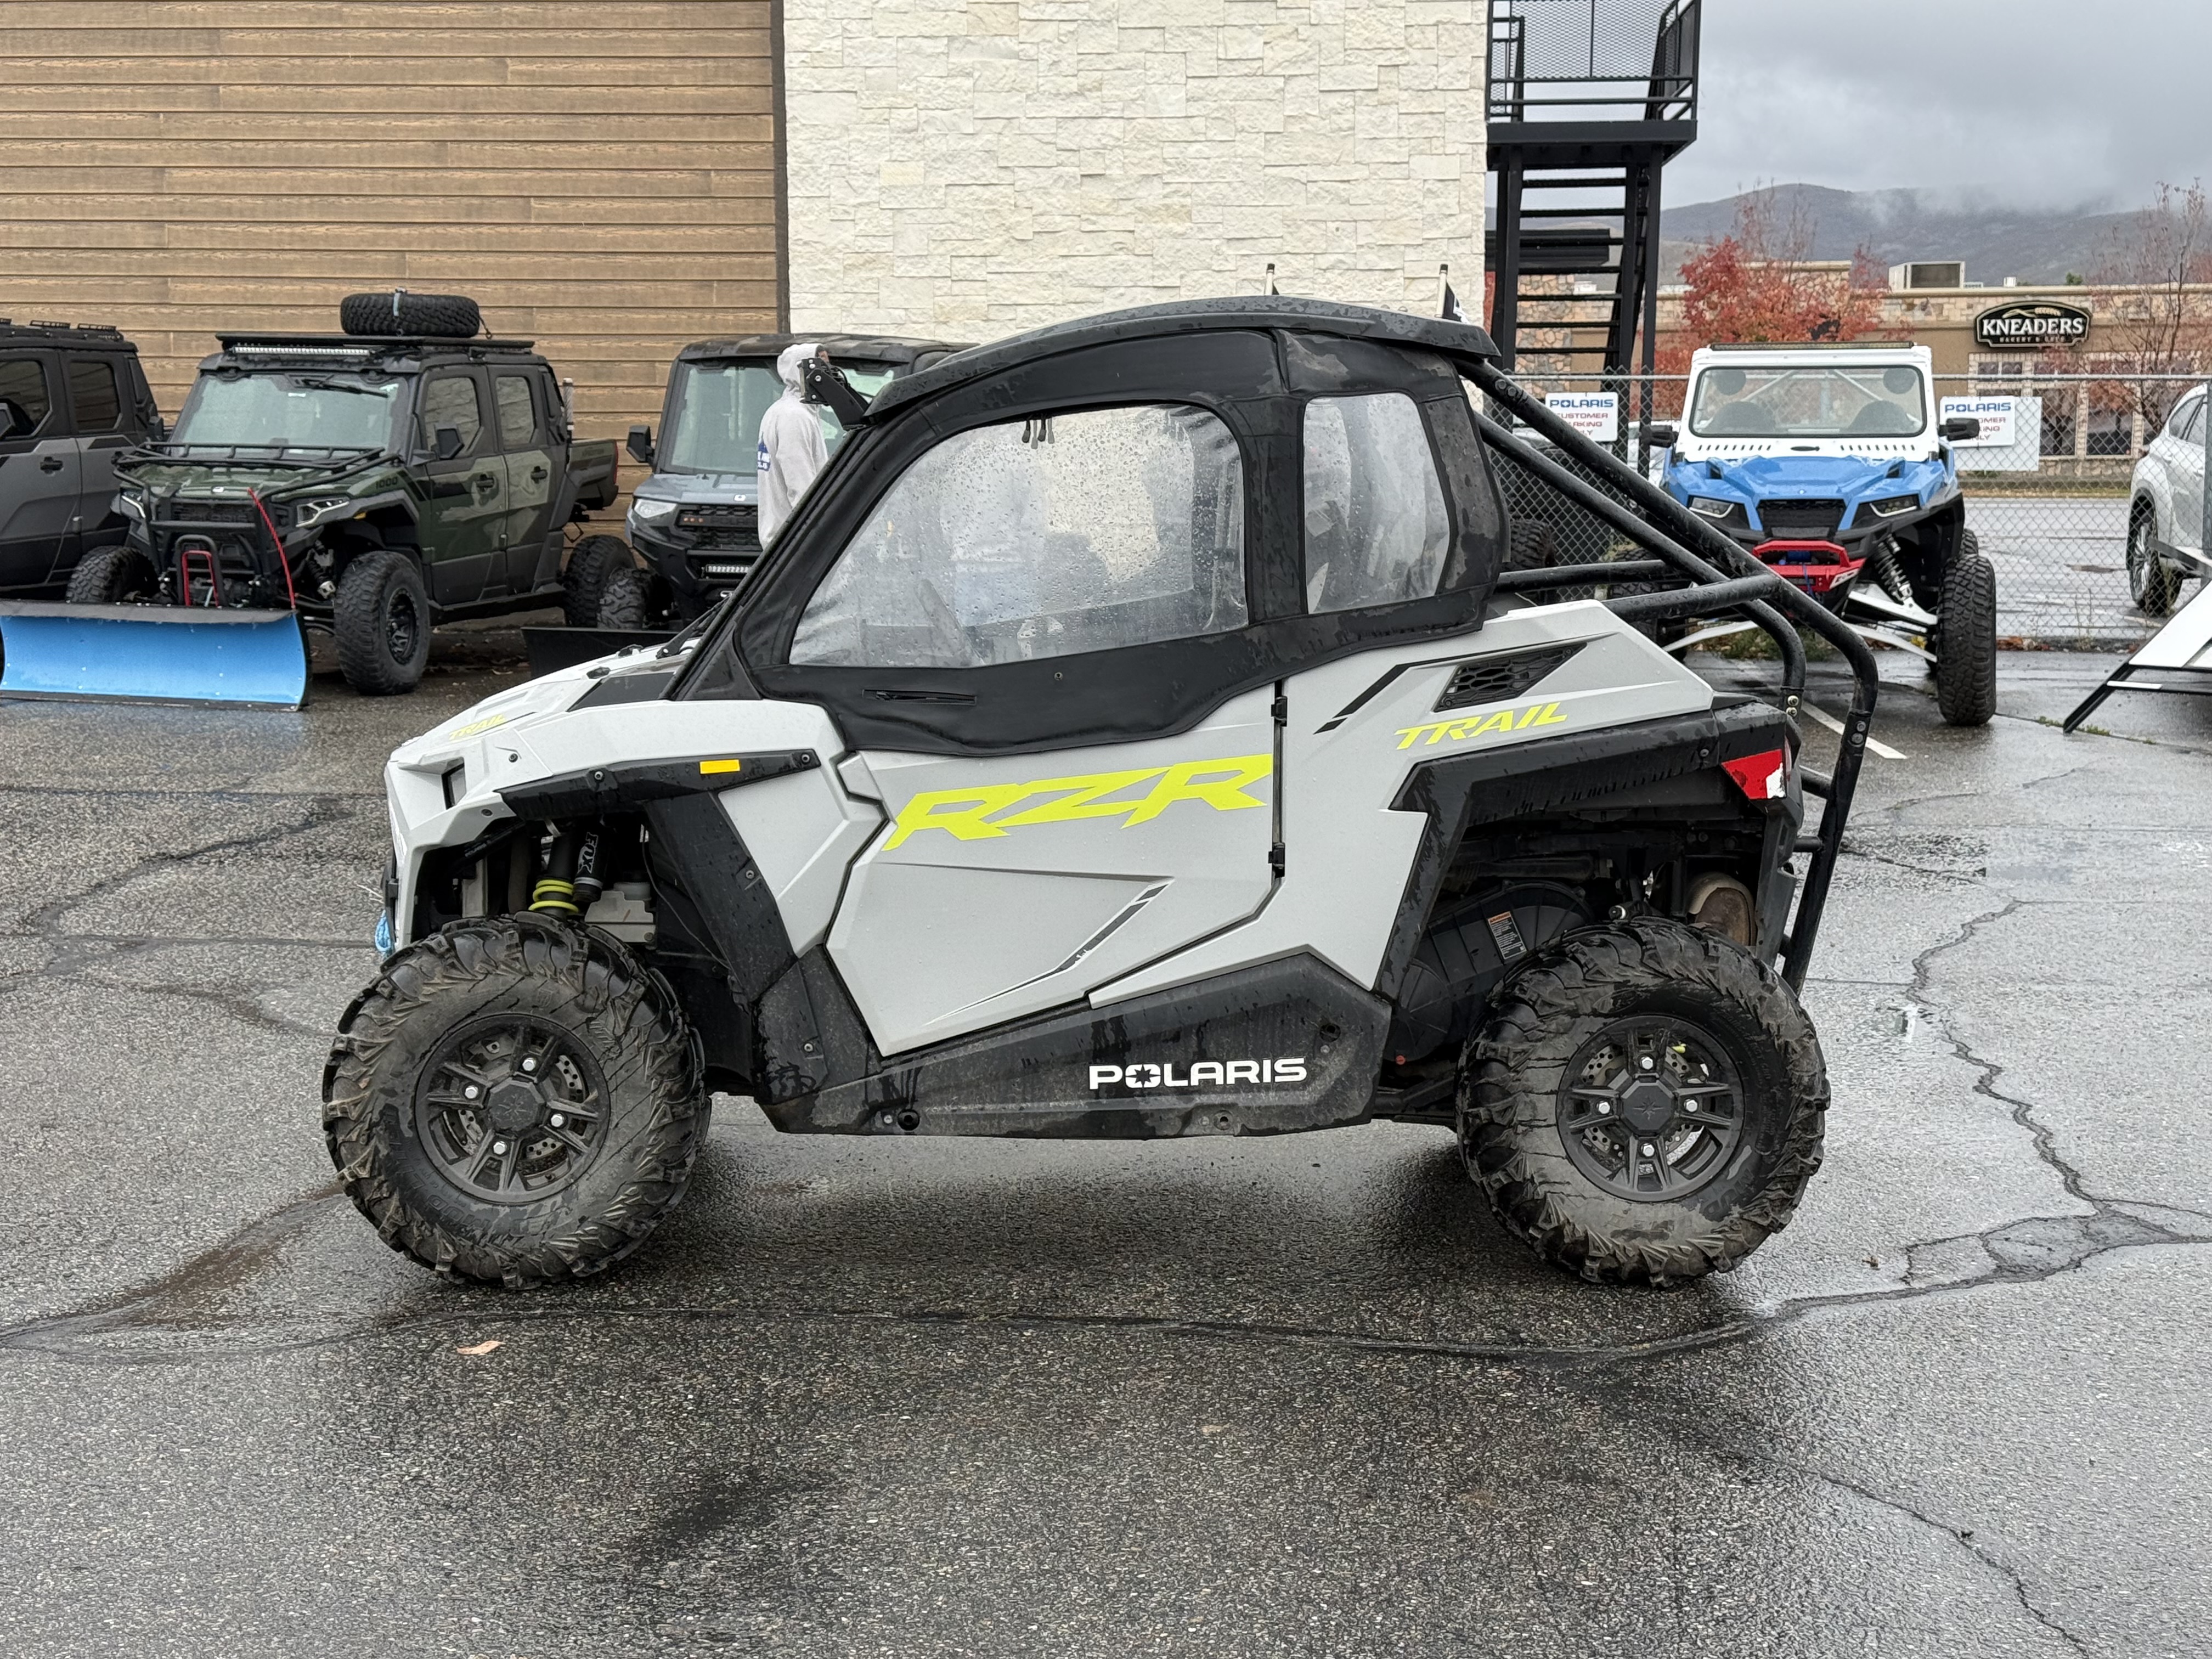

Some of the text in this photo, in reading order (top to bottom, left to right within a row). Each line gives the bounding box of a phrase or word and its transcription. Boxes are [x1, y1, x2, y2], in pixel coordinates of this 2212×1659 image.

[1982, 318, 2085, 336] KNEADERS
[1550, 399, 1613, 408] POLARIS
[1945, 402, 2011, 413] POLARIS
[375, 477, 398, 489] 1000
[449, 714, 505, 741] TRAIL
[1394, 702, 1567, 750] TRAIL
[881, 754, 1272, 851] RZR
[577, 832, 599, 874] FOX
[1089, 1058, 1307, 1090] POLARIS
